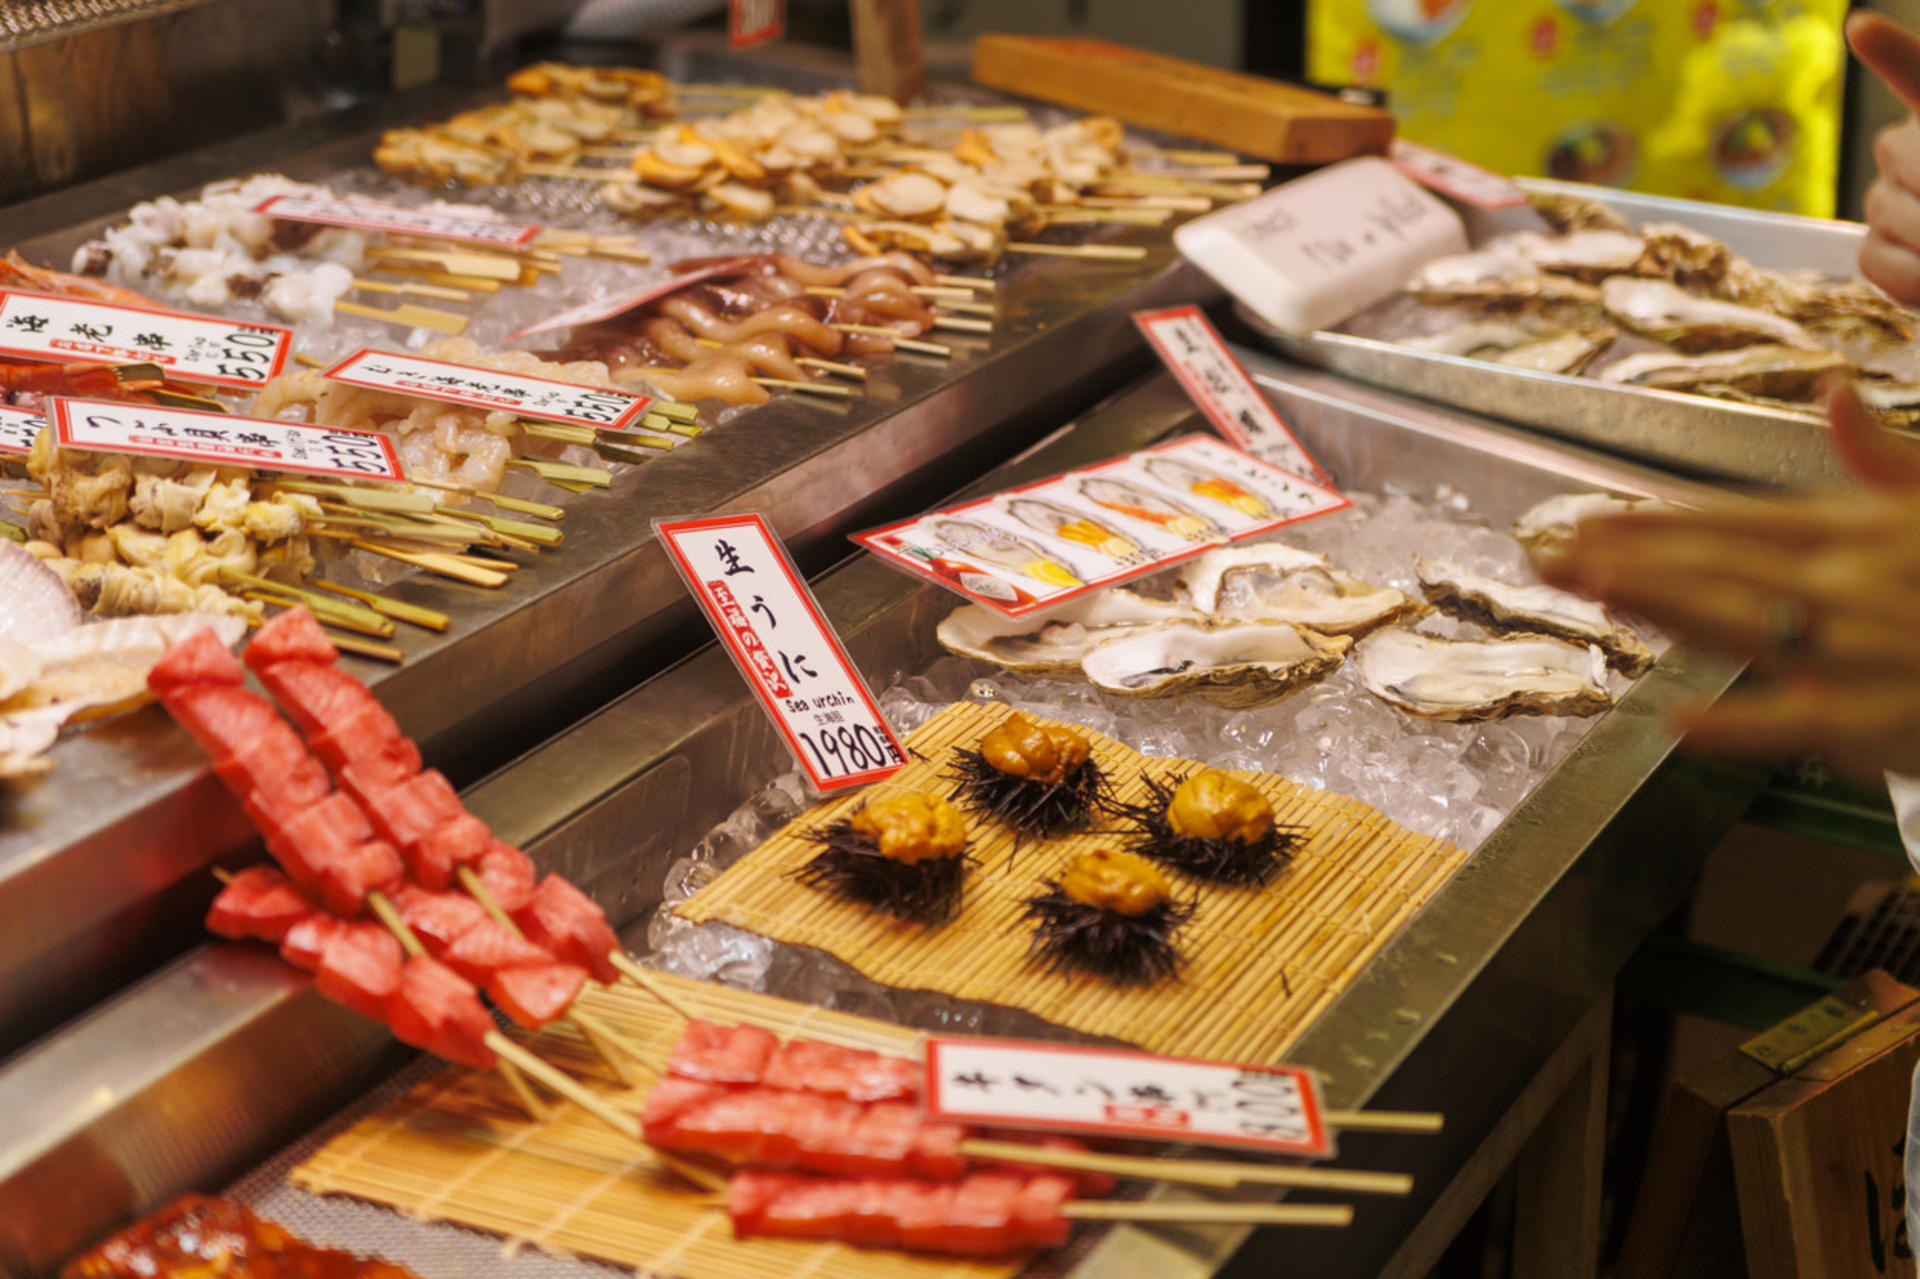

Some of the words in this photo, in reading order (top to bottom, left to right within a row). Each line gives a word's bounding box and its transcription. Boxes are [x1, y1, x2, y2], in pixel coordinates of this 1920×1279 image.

[6, 315, 173, 351] 海老串
[217, 334, 276, 380] 550
[564, 393, 631, 421] 550
[86, 415, 281, 448] つぶ貝串
[321, 435, 387, 473] 550
[714, 538, 818, 684] 生うに
[798, 723, 886, 777] 1980
